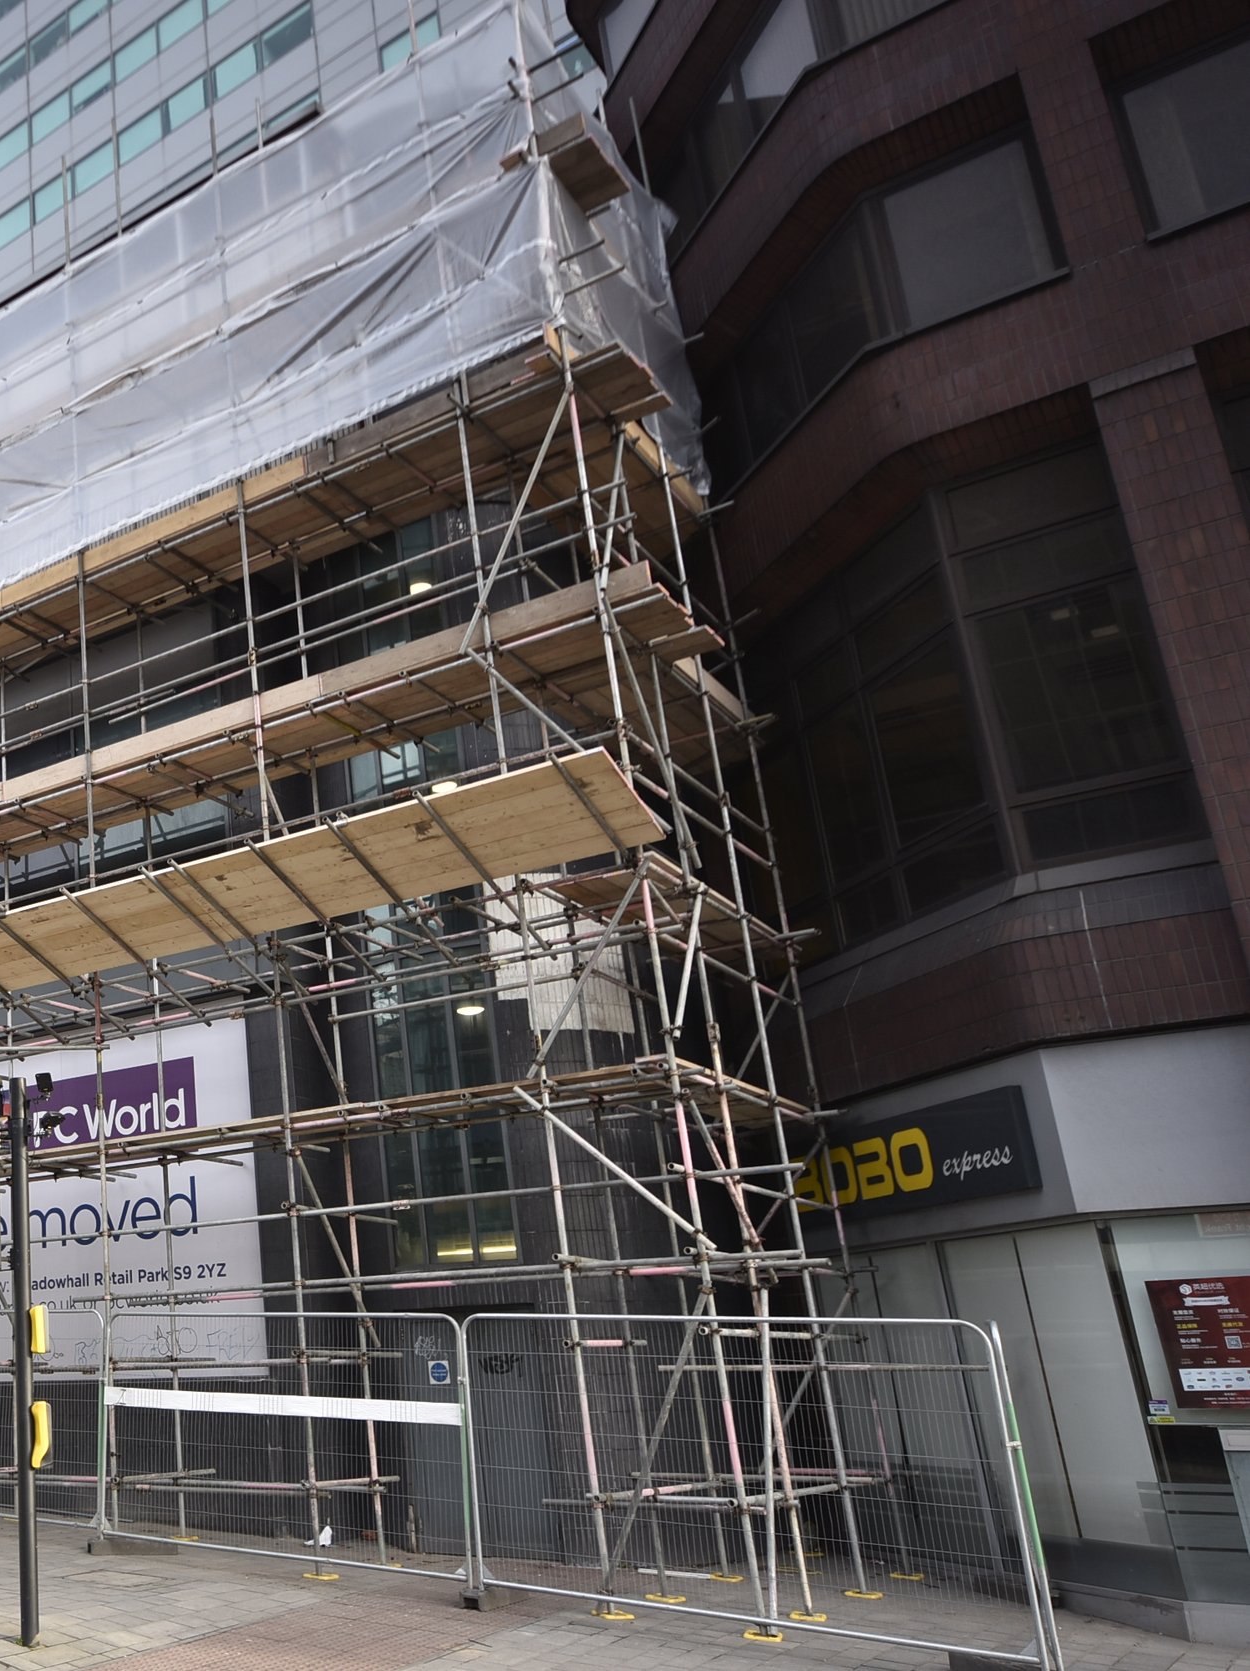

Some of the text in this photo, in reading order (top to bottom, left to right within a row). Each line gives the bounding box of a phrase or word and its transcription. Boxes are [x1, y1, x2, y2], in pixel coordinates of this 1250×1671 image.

[83, 1087, 187, 1140] World
[788, 1127, 1014, 1213] BOBO express
[29, 1175, 199, 1249] moved
[138, 1266, 169, 1283] Park
[174, 1265, 192, 1281] S9
[197, 1263, 227, 1279] 2YZ
